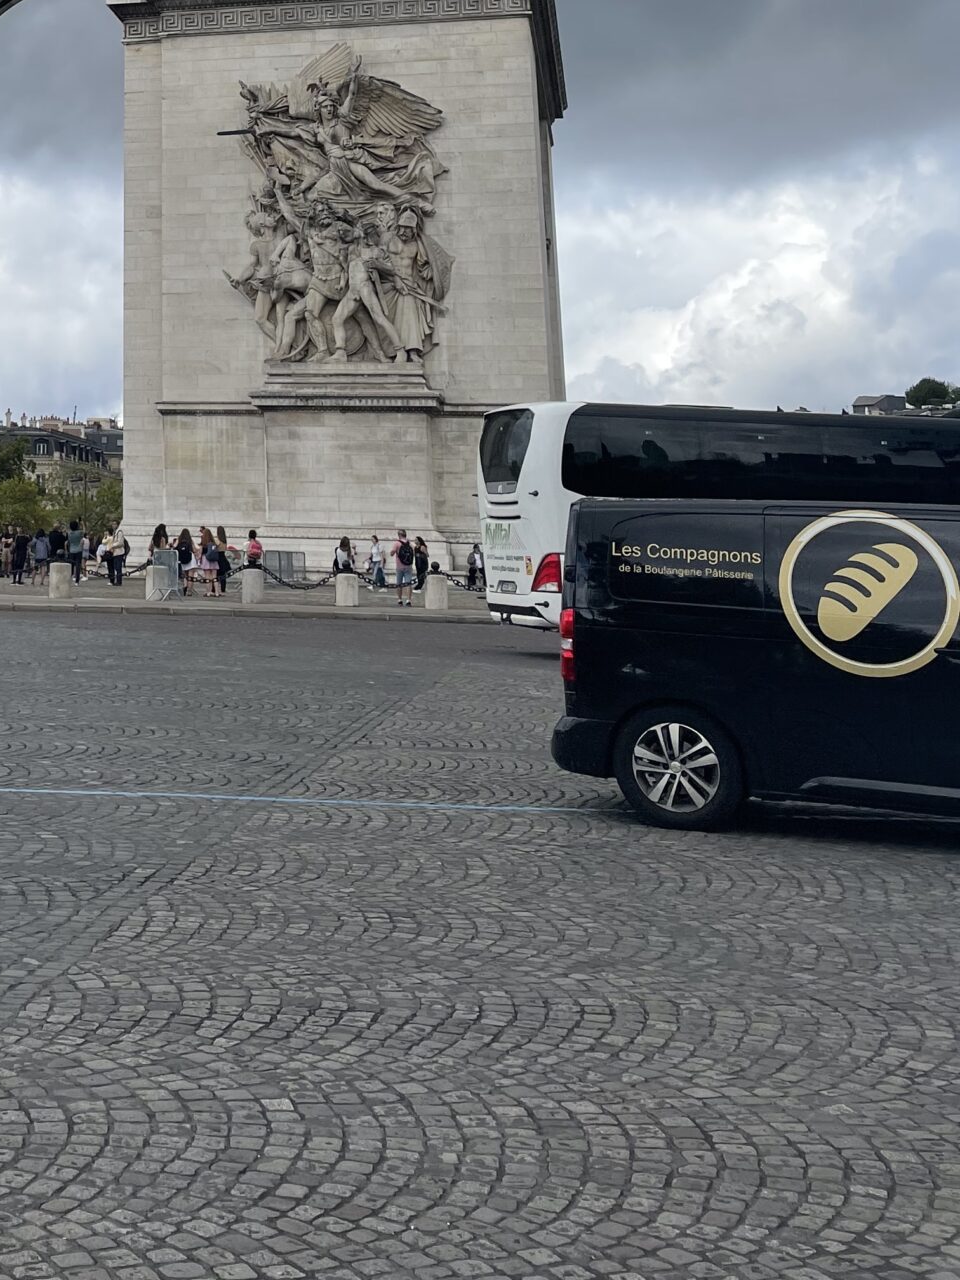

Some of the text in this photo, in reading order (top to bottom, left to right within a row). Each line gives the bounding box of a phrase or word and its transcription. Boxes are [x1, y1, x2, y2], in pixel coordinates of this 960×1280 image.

[611, 541, 762, 565] Les Compagnons
[618, 563, 754, 579] de la Boulangerie Pâtisserie
